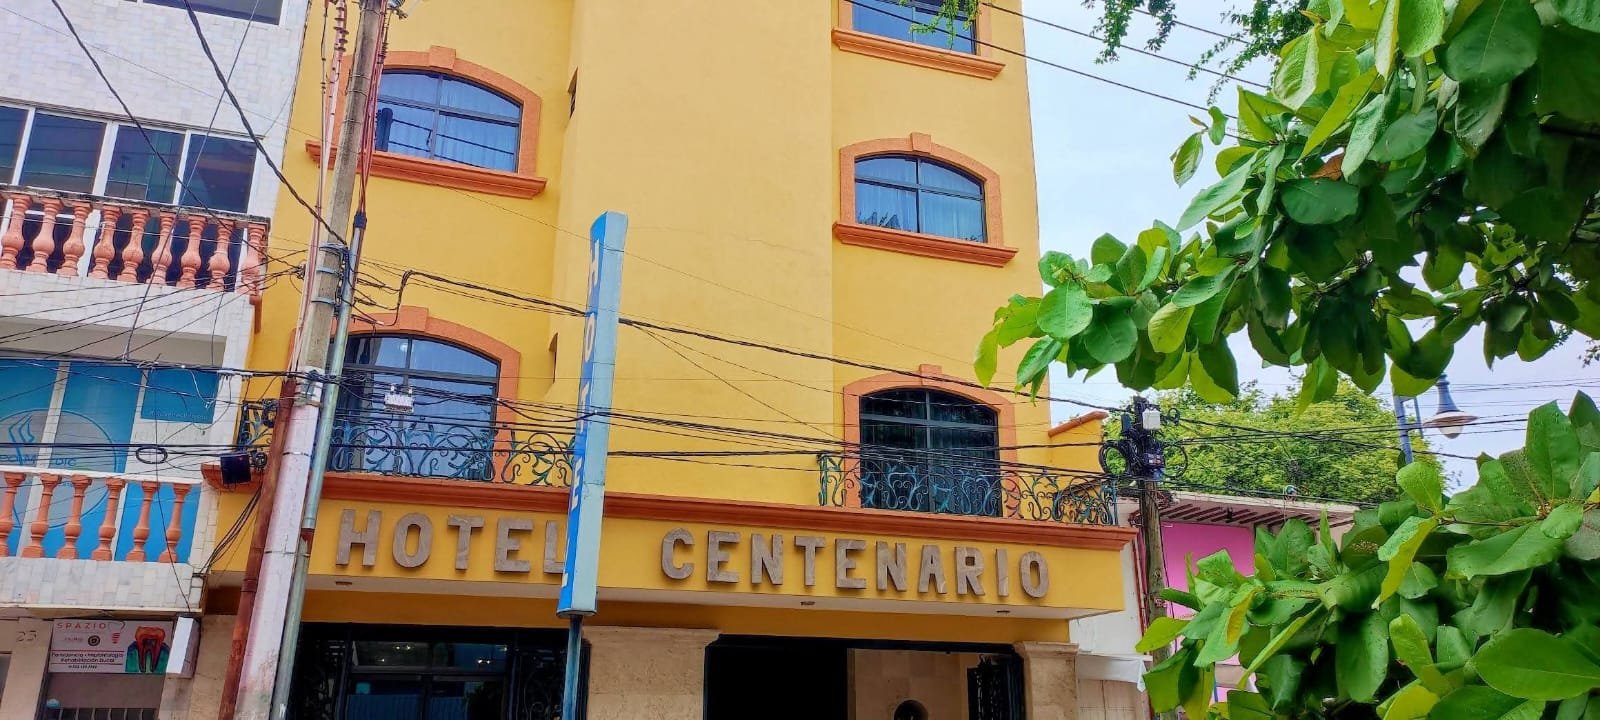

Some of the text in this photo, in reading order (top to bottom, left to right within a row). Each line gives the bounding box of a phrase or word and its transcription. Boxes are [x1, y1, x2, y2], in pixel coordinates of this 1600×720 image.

[335, 508, 1050, 599] HOTEL CENTENARIO
[57, 622, 106, 630] SPAZIO
